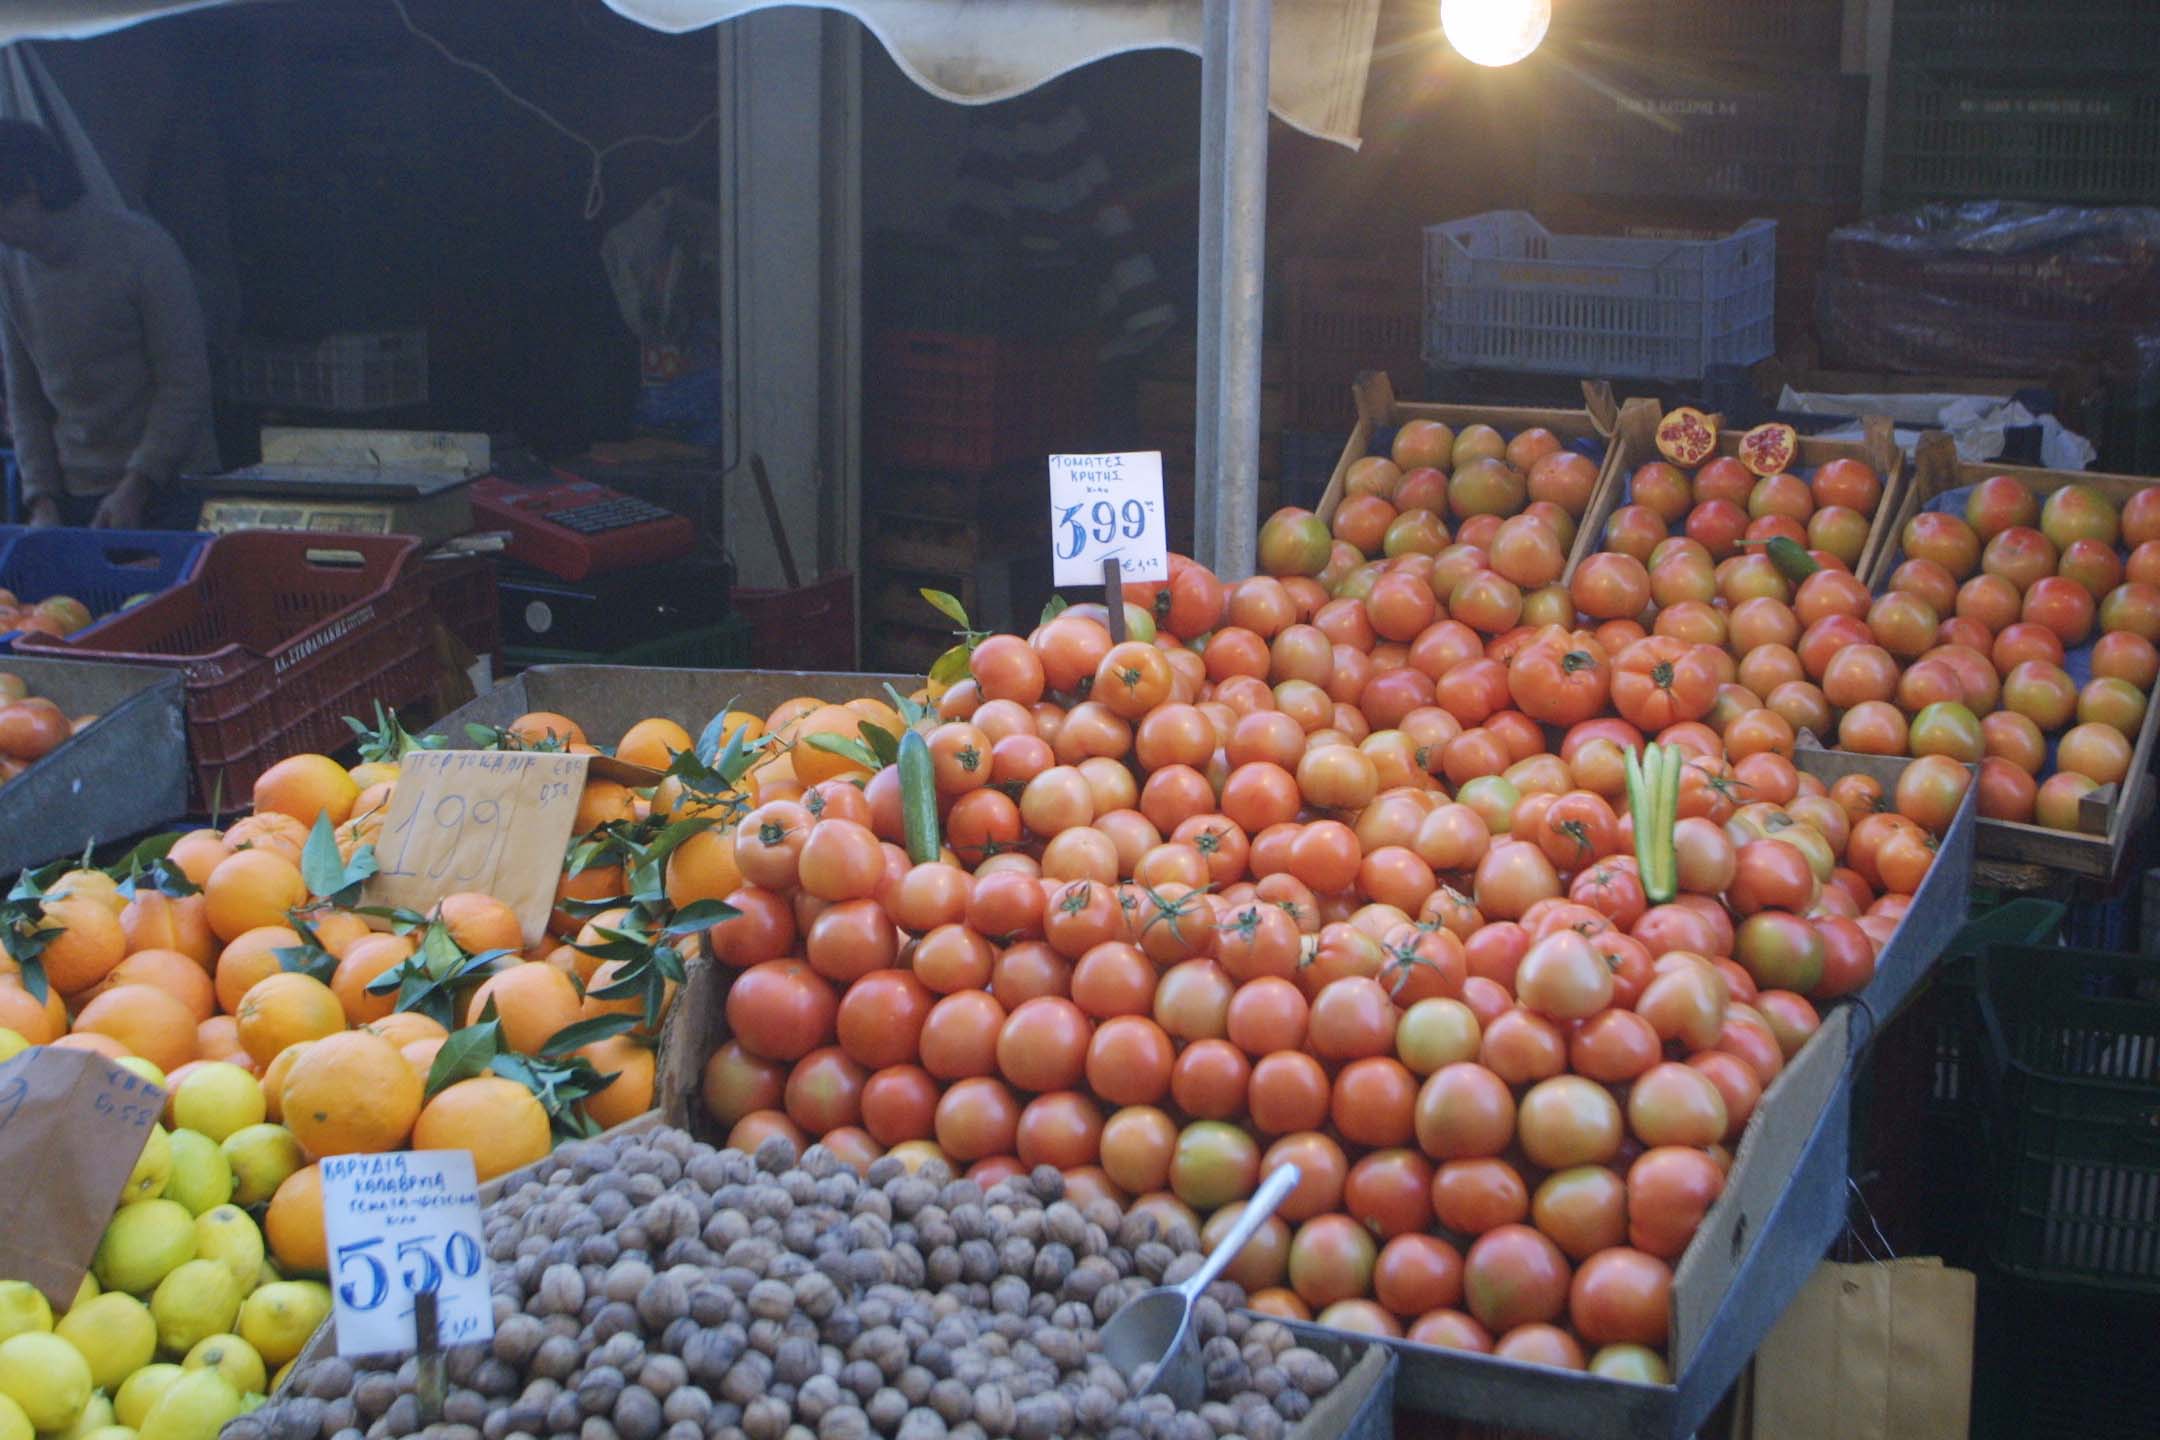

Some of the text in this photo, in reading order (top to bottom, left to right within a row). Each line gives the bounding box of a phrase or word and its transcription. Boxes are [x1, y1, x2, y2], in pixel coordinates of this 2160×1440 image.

[1071, 470, 1124, 482] ΚΡΗΤΗΣ
[1054, 499, 1146, 560] 399
[383, 791, 500, 881] 199
[323, 1155, 407, 1180] ΚΑΡΥΔΙΑ
[337, 1231, 482, 1311] 550
